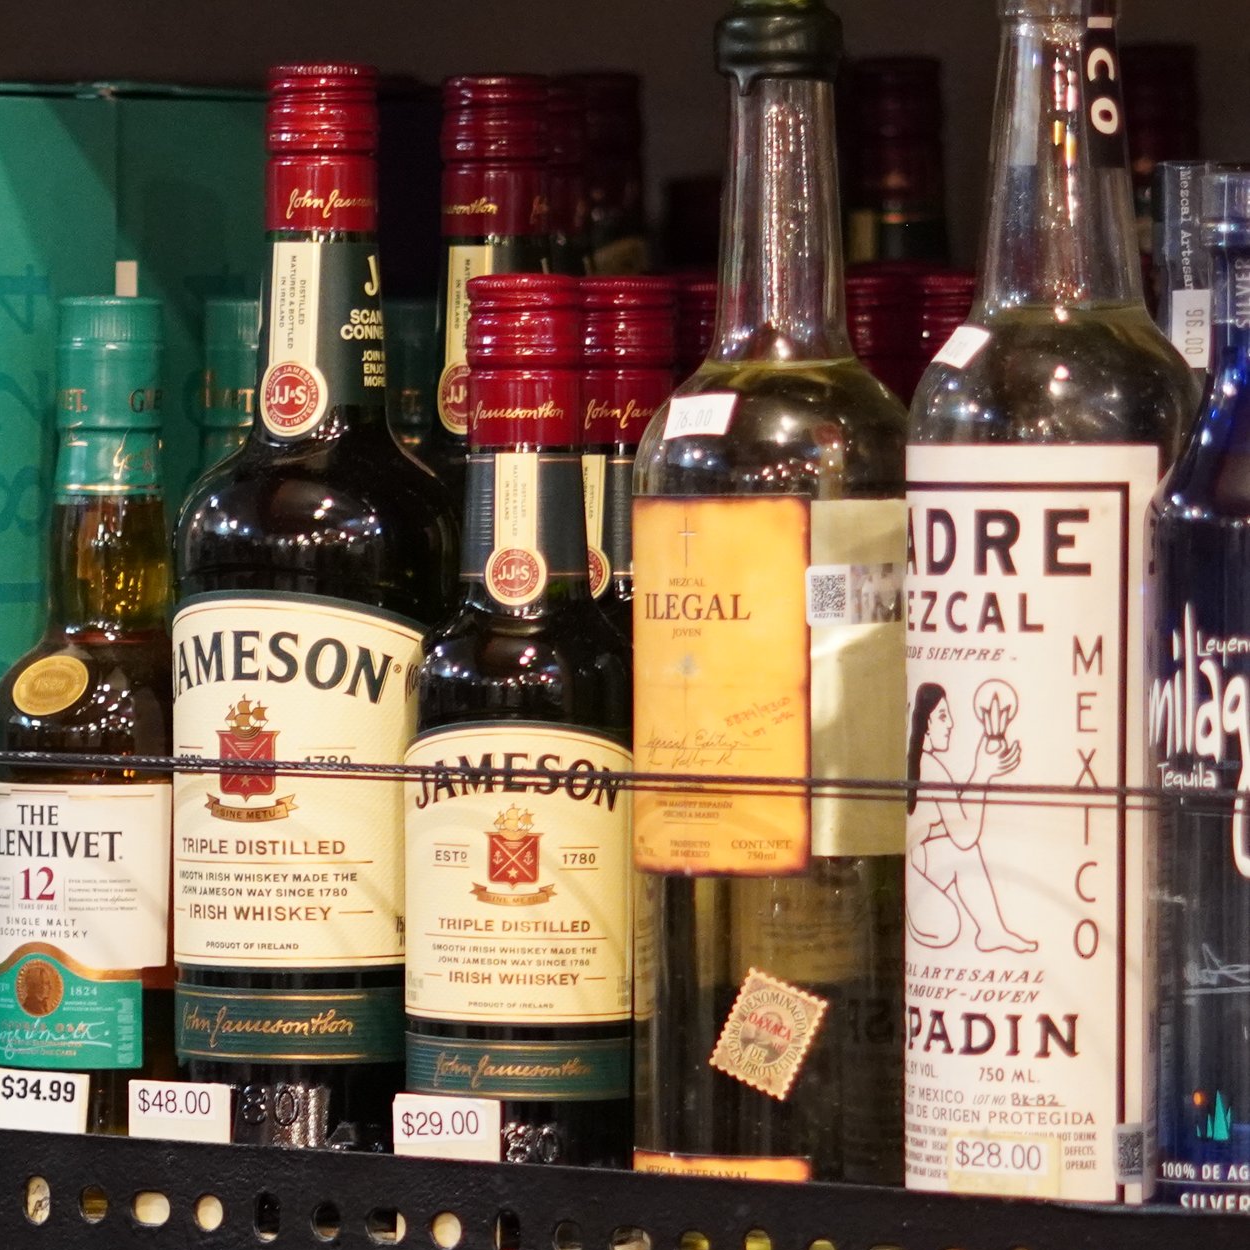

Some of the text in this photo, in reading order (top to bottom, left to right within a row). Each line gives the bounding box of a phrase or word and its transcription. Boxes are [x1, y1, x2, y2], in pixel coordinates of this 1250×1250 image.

[270, 385, 308, 405] JJ&S
[645, 594, 751, 621] ILEGAL
[672, 628, 702, 639] JOVEN
[927, 647, 1005, 661] SIEMPRE
[415, 753, 622, 812] JAMESON
[1157, 762, 1217, 790] Tequila
[17, 805, 59, 825] THE
[183, 838, 346, 855] TRIPLE DISTILLED
[562, 854, 596, 864] 1780
[20, 866, 56, 901] 12
[206, 871, 358, 882] IRISH WHISKEY MADE THE
[199, 887, 348, 897] JAMESON WAY SINCE 1780
[189, 904, 332, 921] IRISH WHISKEY
[6, 916, 77, 926] SINGLE MALT
[438, 918, 591, 933] TRIPLE DISTILLED
[0, 927, 89, 938] SCOTCH WHISKY
[206, 941, 240, 949] PRODUCT
[469, 945, 496, 954] IRISH
[500, 947, 547, 955] WHISKEY
[438, 956, 459, 964] JOHN
[462, 957, 507, 966] JAMESON
[449, 972, 580, 986] IRISH WHISKEY
[922, 964, 1046, 984] ARTESANAL
[70, 986, 97, 996] 1824
[970, 990, 1040, 1003] JOVEN
[468, 1001, 504, 1009] PRODUCT
[978, 1067, 1004, 1082] 750
[1, 1075, 76, 1103] $34.99
[918, 1087, 964, 1104] MEXICO
[138, 1088, 211, 1115] $48.00
[916, 1106, 1095, 1125] DE ORIGEN PROTEGIDA
[401, 1110, 479, 1137] $29.00
[956, 1140, 1042, 1171] $28.00
[1065, 1160, 1097, 1170] OPERATE
[1162, 1162, 1220, 1180] 100% DE
